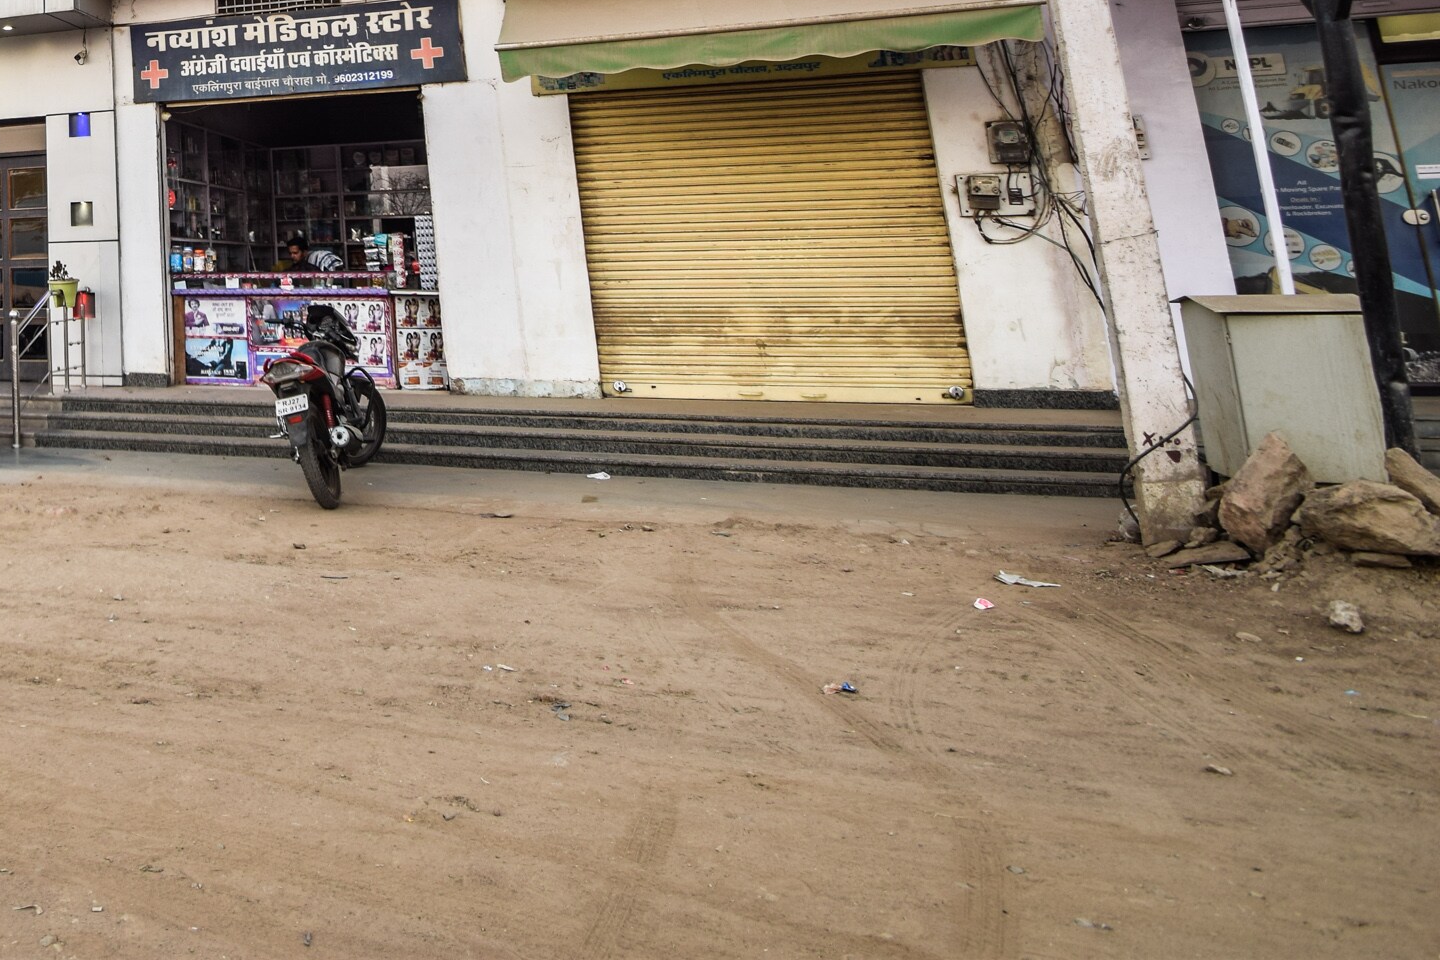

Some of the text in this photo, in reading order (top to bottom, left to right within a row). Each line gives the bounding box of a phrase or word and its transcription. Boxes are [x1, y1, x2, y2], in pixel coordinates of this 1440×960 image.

[145, 1, 434, 52] नव्यांश मेडिकल स्टोर
[180, 42, 398, 77] अंग्रेजी दवाईयाँ एवं कॉस्मेटिक्स
[1224, 57, 1272, 71] NPL
[192, 69, 394, 94] एकलिंगपुरा बाईपास चौराहा मो. 9602312199
[282, 397, 300, 407] RJ27
